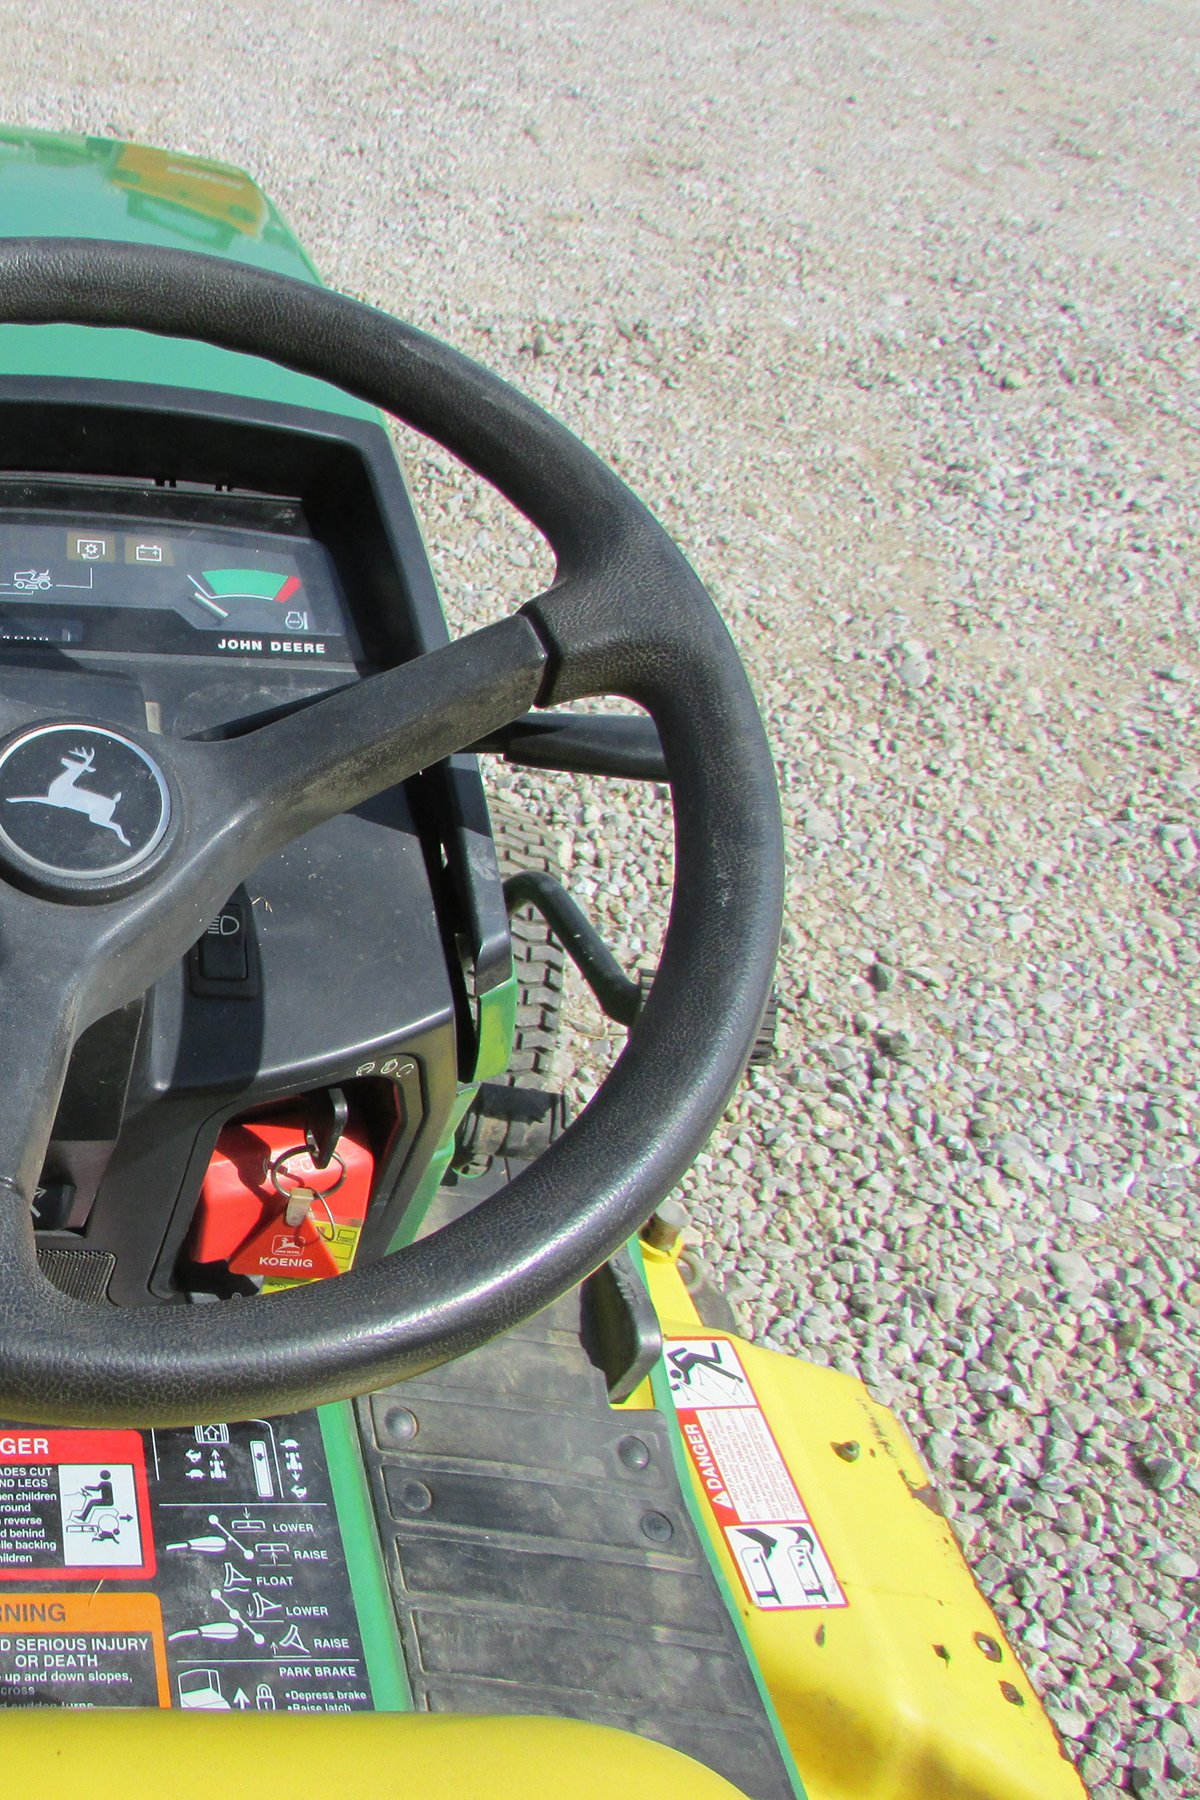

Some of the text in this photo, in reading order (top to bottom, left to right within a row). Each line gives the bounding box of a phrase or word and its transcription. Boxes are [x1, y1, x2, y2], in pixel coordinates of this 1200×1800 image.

[218, 639, 325, 653] JOHN DEERE
[259, 1257, 313, 1267] KOENIG
[682, 1423, 723, 1489] DANGER
[30, 1467, 52, 1476] CUT
[18, 1479, 48, 1488] LEGS
[16, 1492, 56, 1500] children
[273, 1524, 314, 1532] LOWER
[10, 1529, 45, 1538] behind
[16, 1540, 56, 1551] backing
[294, 1550, 328, 1559] RAISE
[256, 1577, 293, 1586] FLOAT
[286, 1606, 328, 1616] LOWER
[16, 1638, 87, 1651] SERIOUS
[92, 1638, 148, 1650] INJURY
[314, 1639, 349, 1648] RAISE
[15, 1654, 98, 1667] OR DEATH
[279, 1667, 356, 1677] PARK BRAKE
[5, 1674, 21, 1685] up
[24, 1672, 47, 1682] and
[50, 1672, 84, 1682] down
[88, 1671, 133, 1683] slopes,
[290, 1690, 366, 1702] Depress brake
